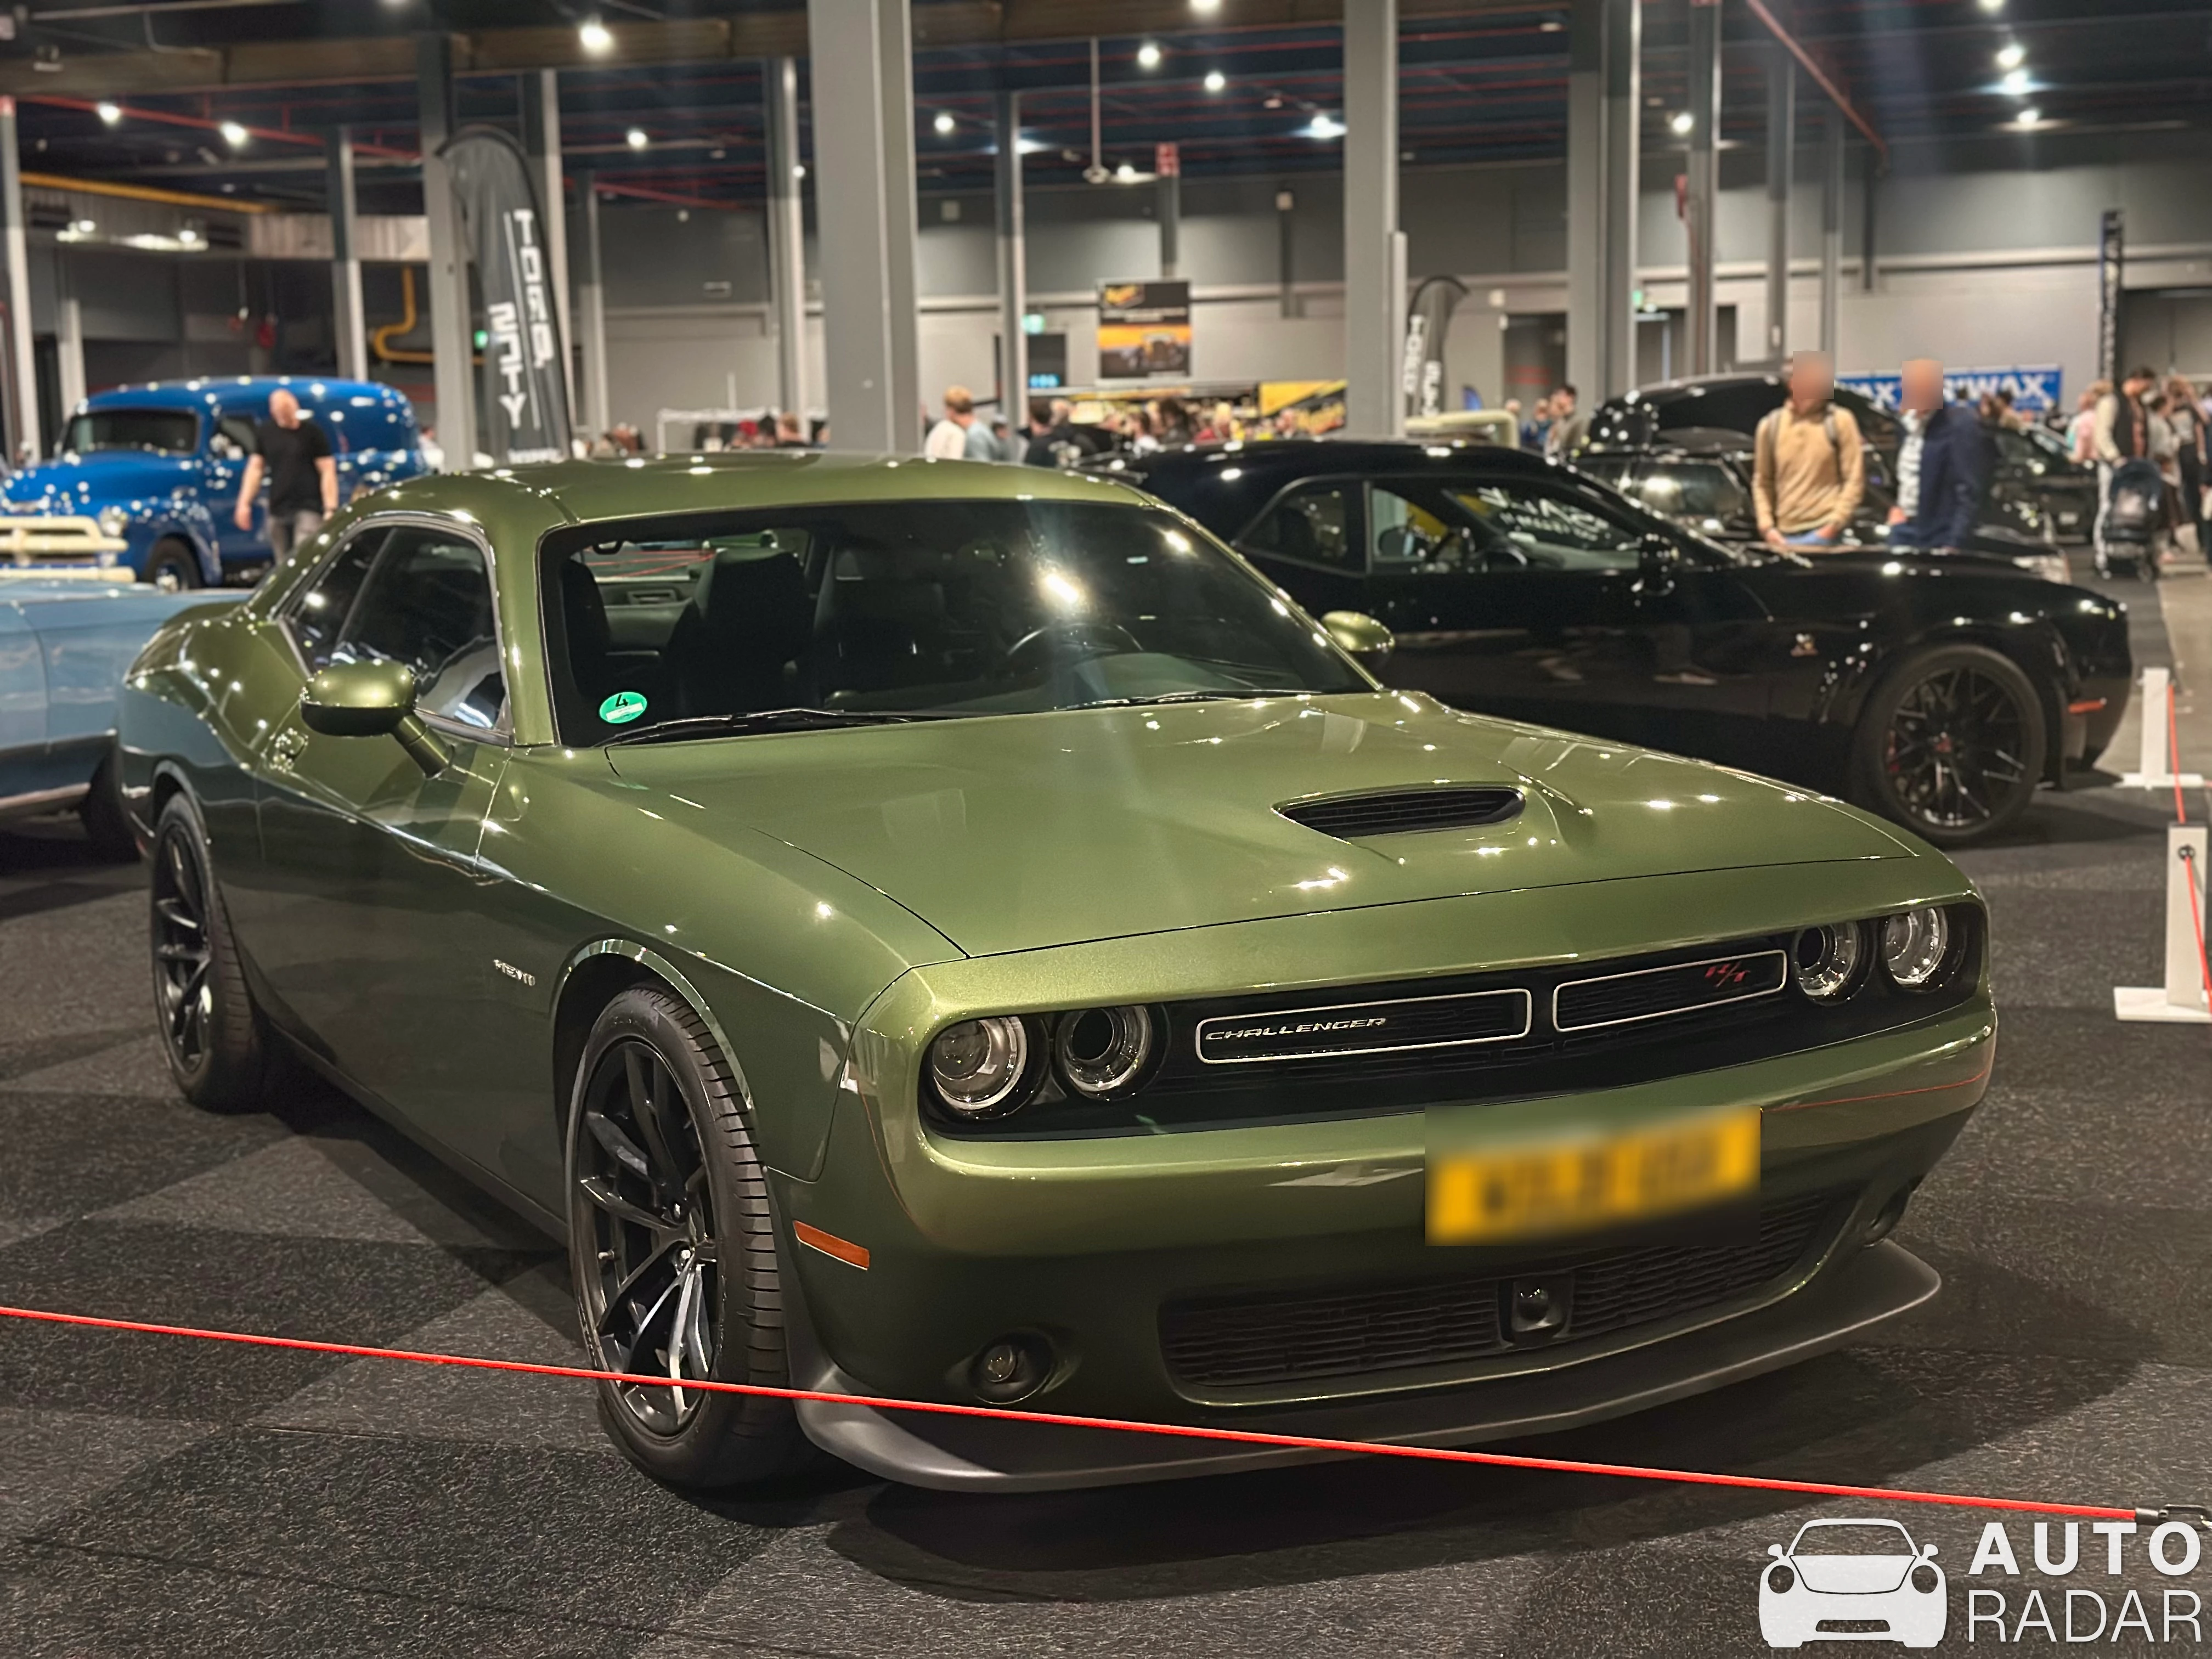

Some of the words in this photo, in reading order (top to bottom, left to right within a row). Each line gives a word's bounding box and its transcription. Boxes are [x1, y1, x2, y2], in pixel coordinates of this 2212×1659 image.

[615, 693, 629, 707] 4
[1704, 961, 1751, 988] R/T
[1205, 1018, 1386, 1040] CHALLENGER
